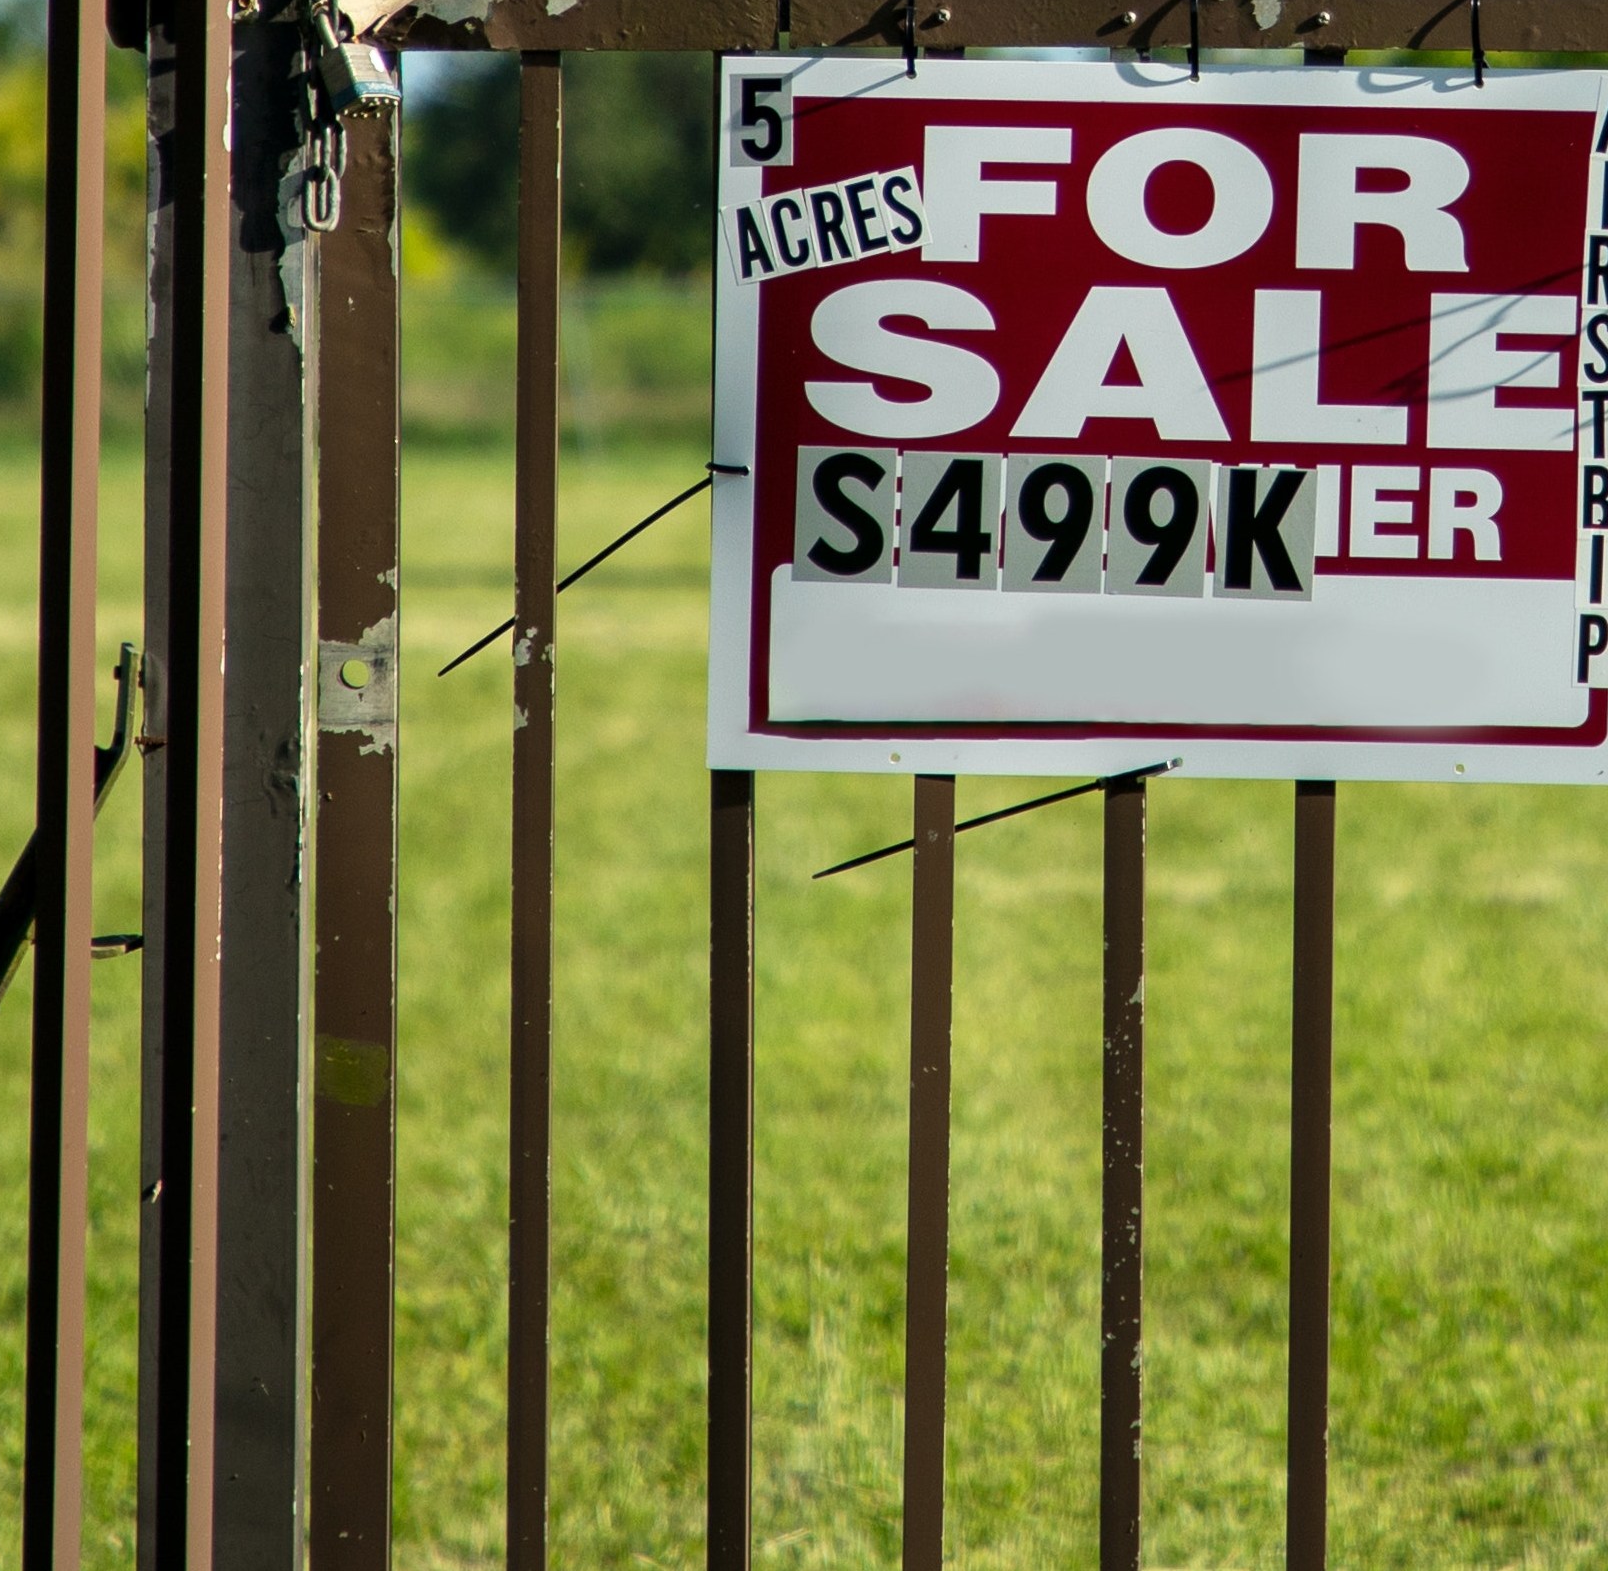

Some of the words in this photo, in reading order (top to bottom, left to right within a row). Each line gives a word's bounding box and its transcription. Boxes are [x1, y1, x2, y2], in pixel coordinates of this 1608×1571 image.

[741, 78, 783, 162] 5
[736, 175, 923, 278] ACRES
[920, 125, 1470, 272] FOR
[804, 278, 1578, 451] SALE
